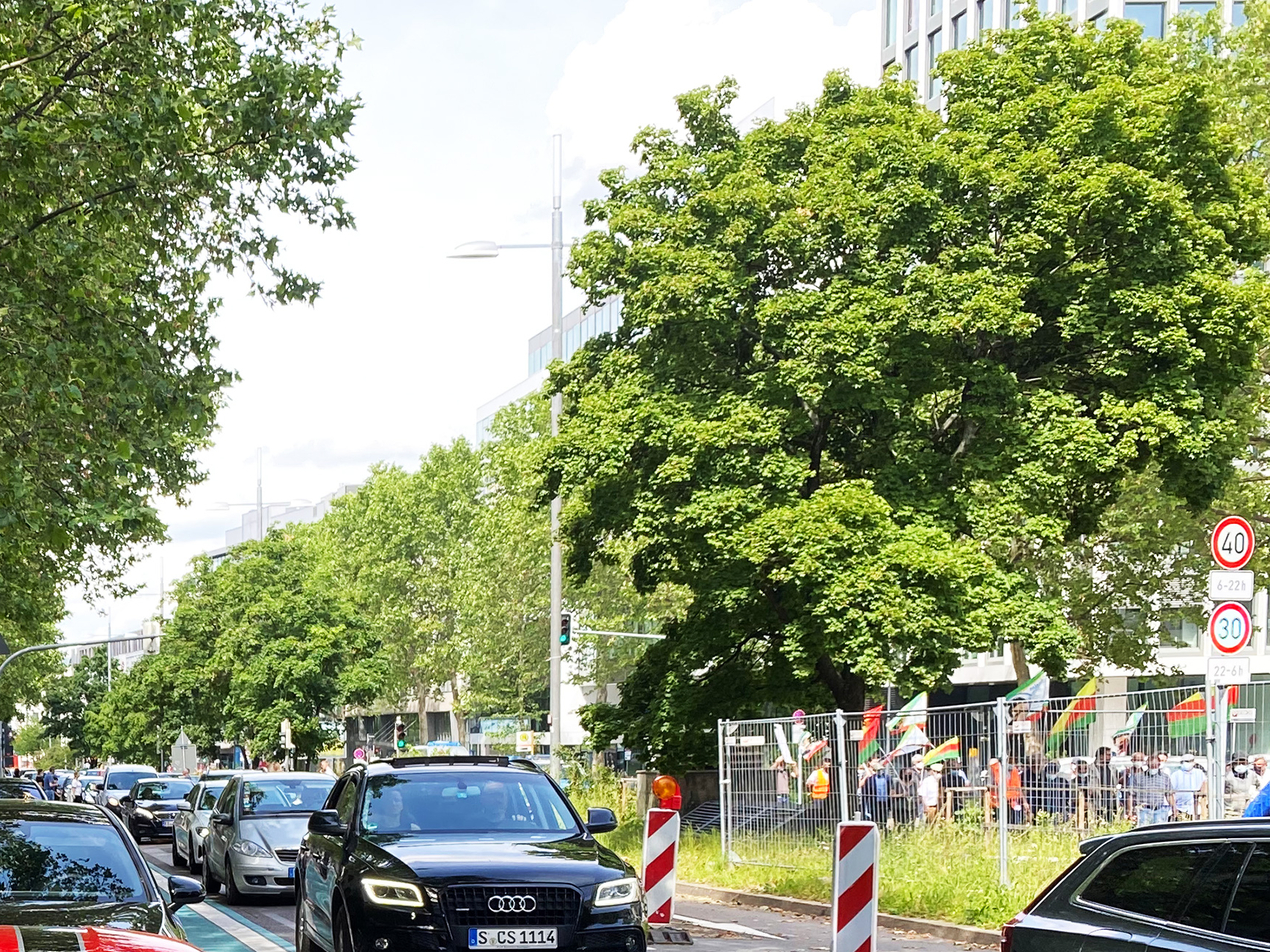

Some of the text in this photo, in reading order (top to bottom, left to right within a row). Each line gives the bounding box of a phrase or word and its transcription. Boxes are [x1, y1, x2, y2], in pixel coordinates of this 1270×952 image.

[1222, 532, 1245, 554] 40
[1218, 617, 1242, 640] 30
[478, 930, 555, 945] S CS 1114
